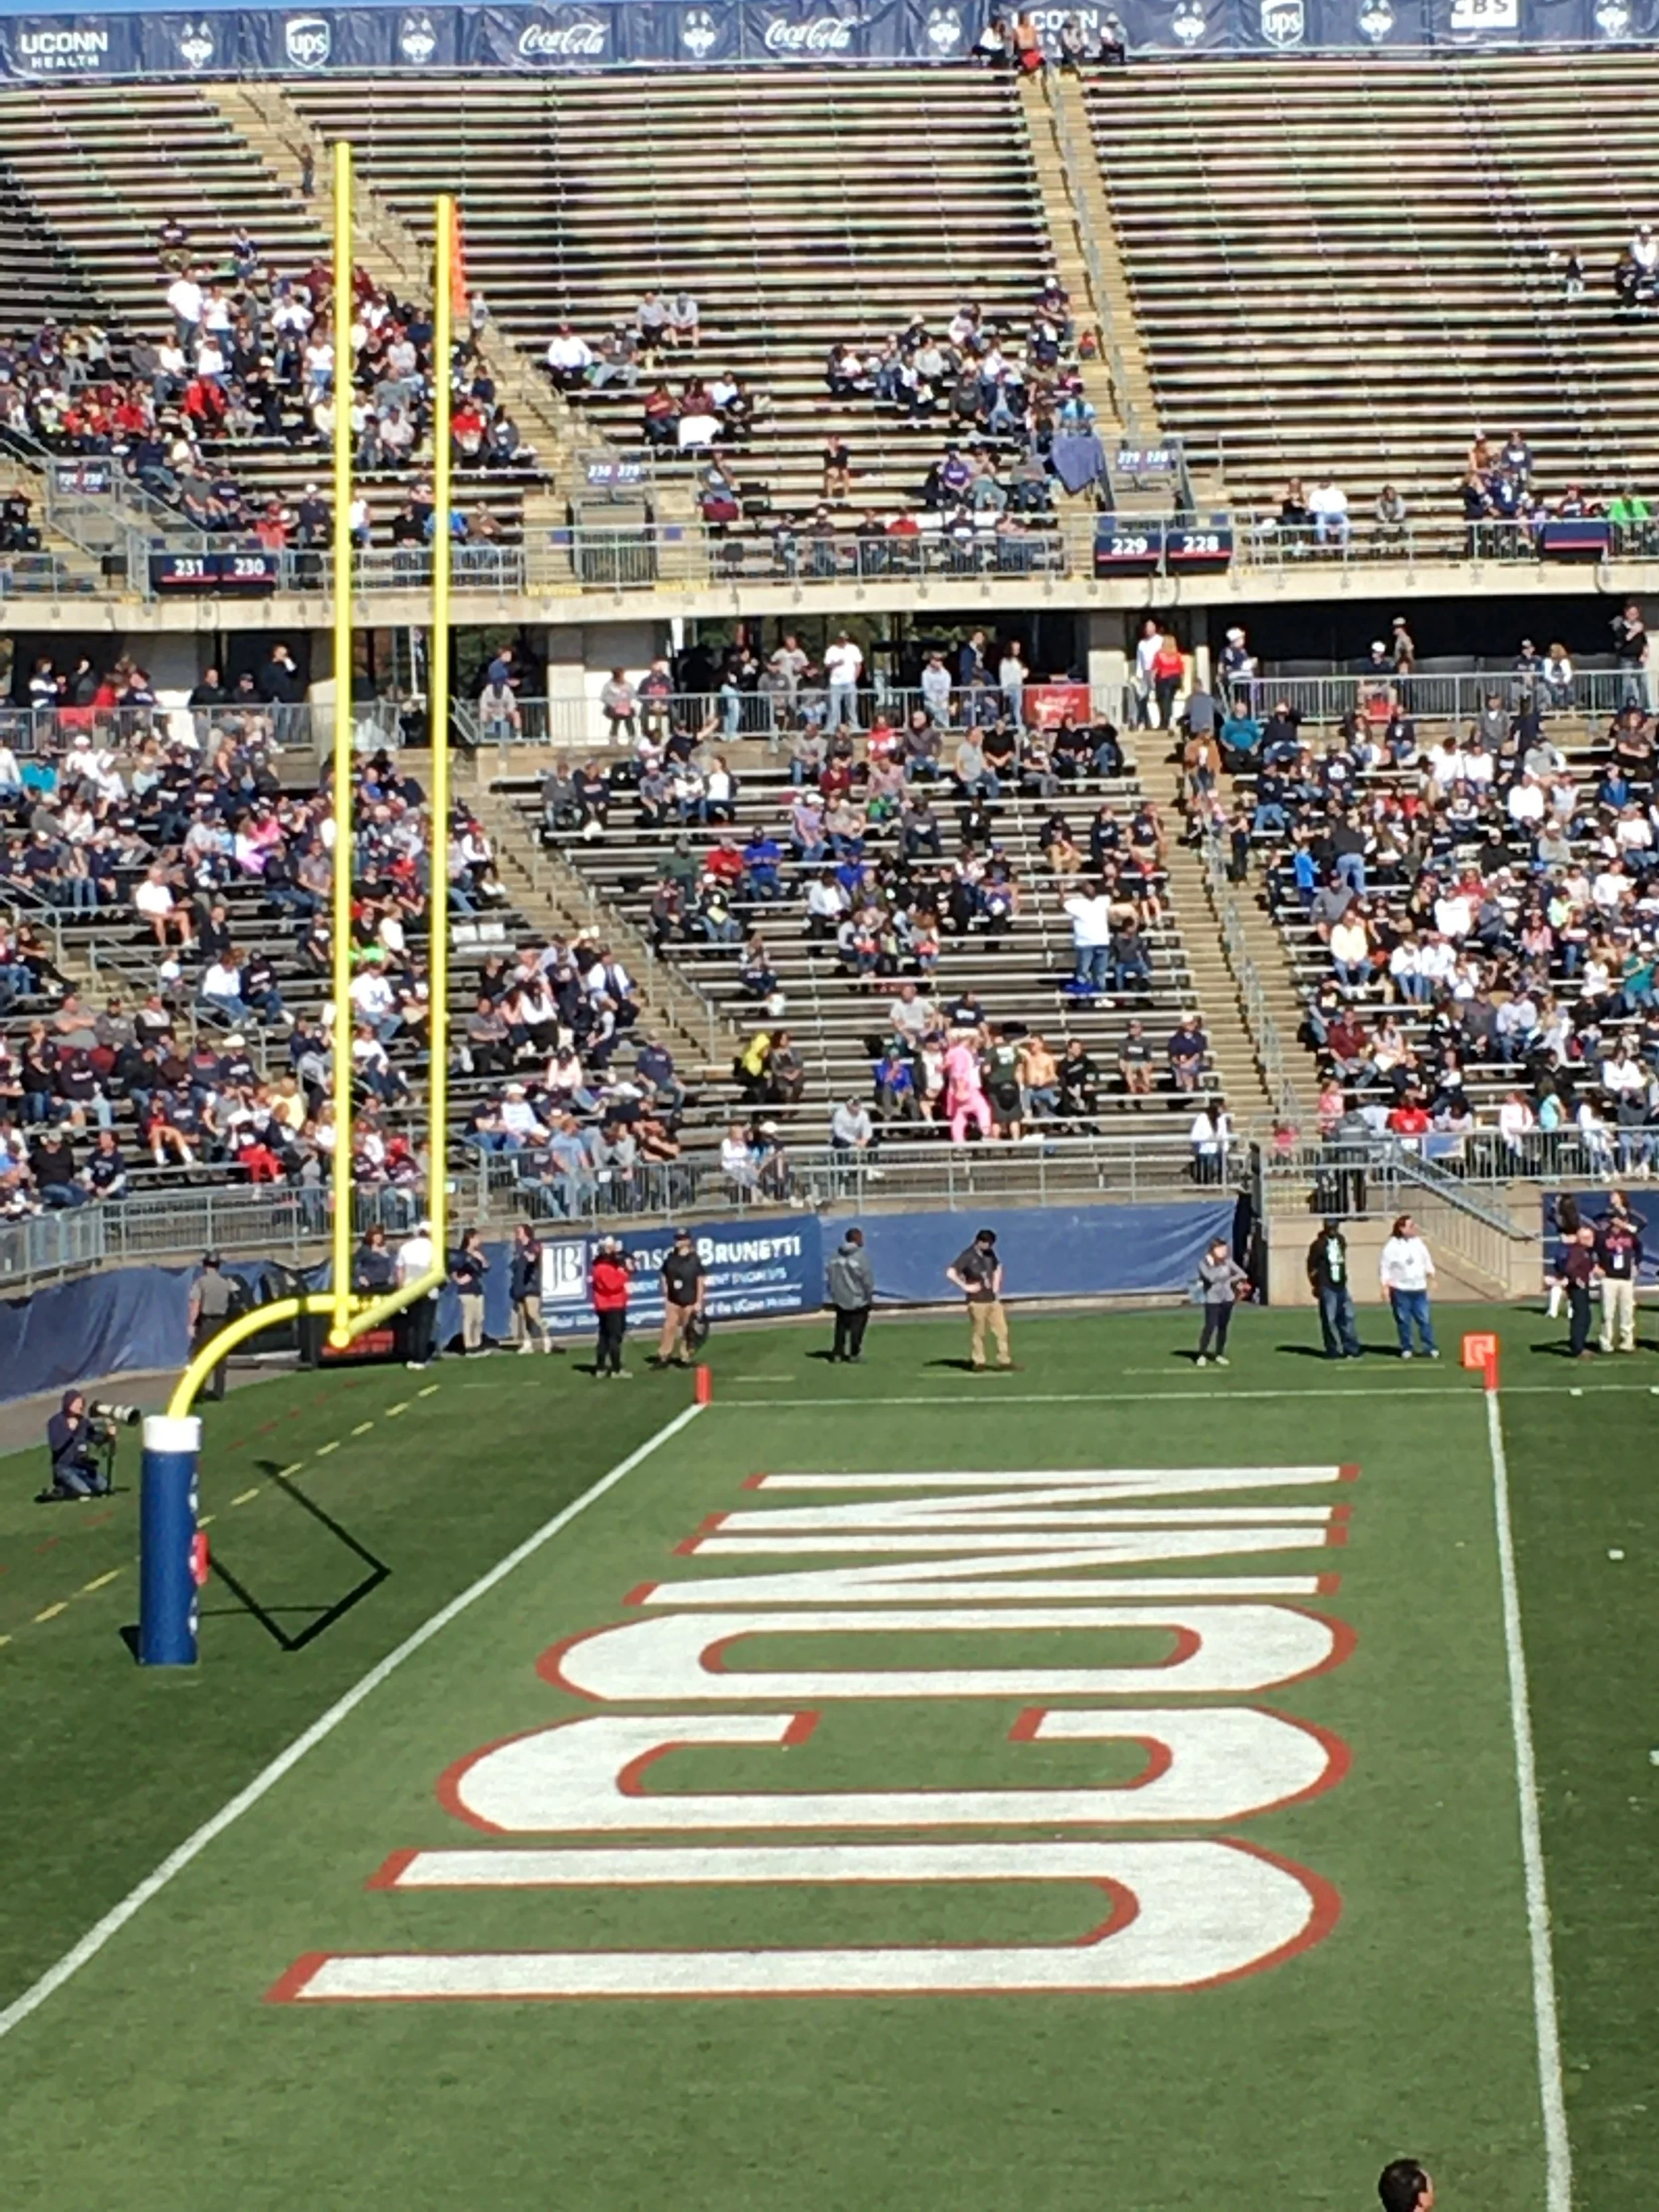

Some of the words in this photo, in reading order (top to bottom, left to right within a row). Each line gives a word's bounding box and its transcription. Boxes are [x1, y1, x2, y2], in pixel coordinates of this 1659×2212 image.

[21, 32, 108, 54] UCONN
[32, 54, 99, 68] HEALTH
[1111, 537, 1148, 556] 229
[1183, 536, 1219, 553] 228
[174, 559, 204, 576] 231
[234, 557, 265, 576] 230
[265, 1464, 1359, 2001] UCONN
